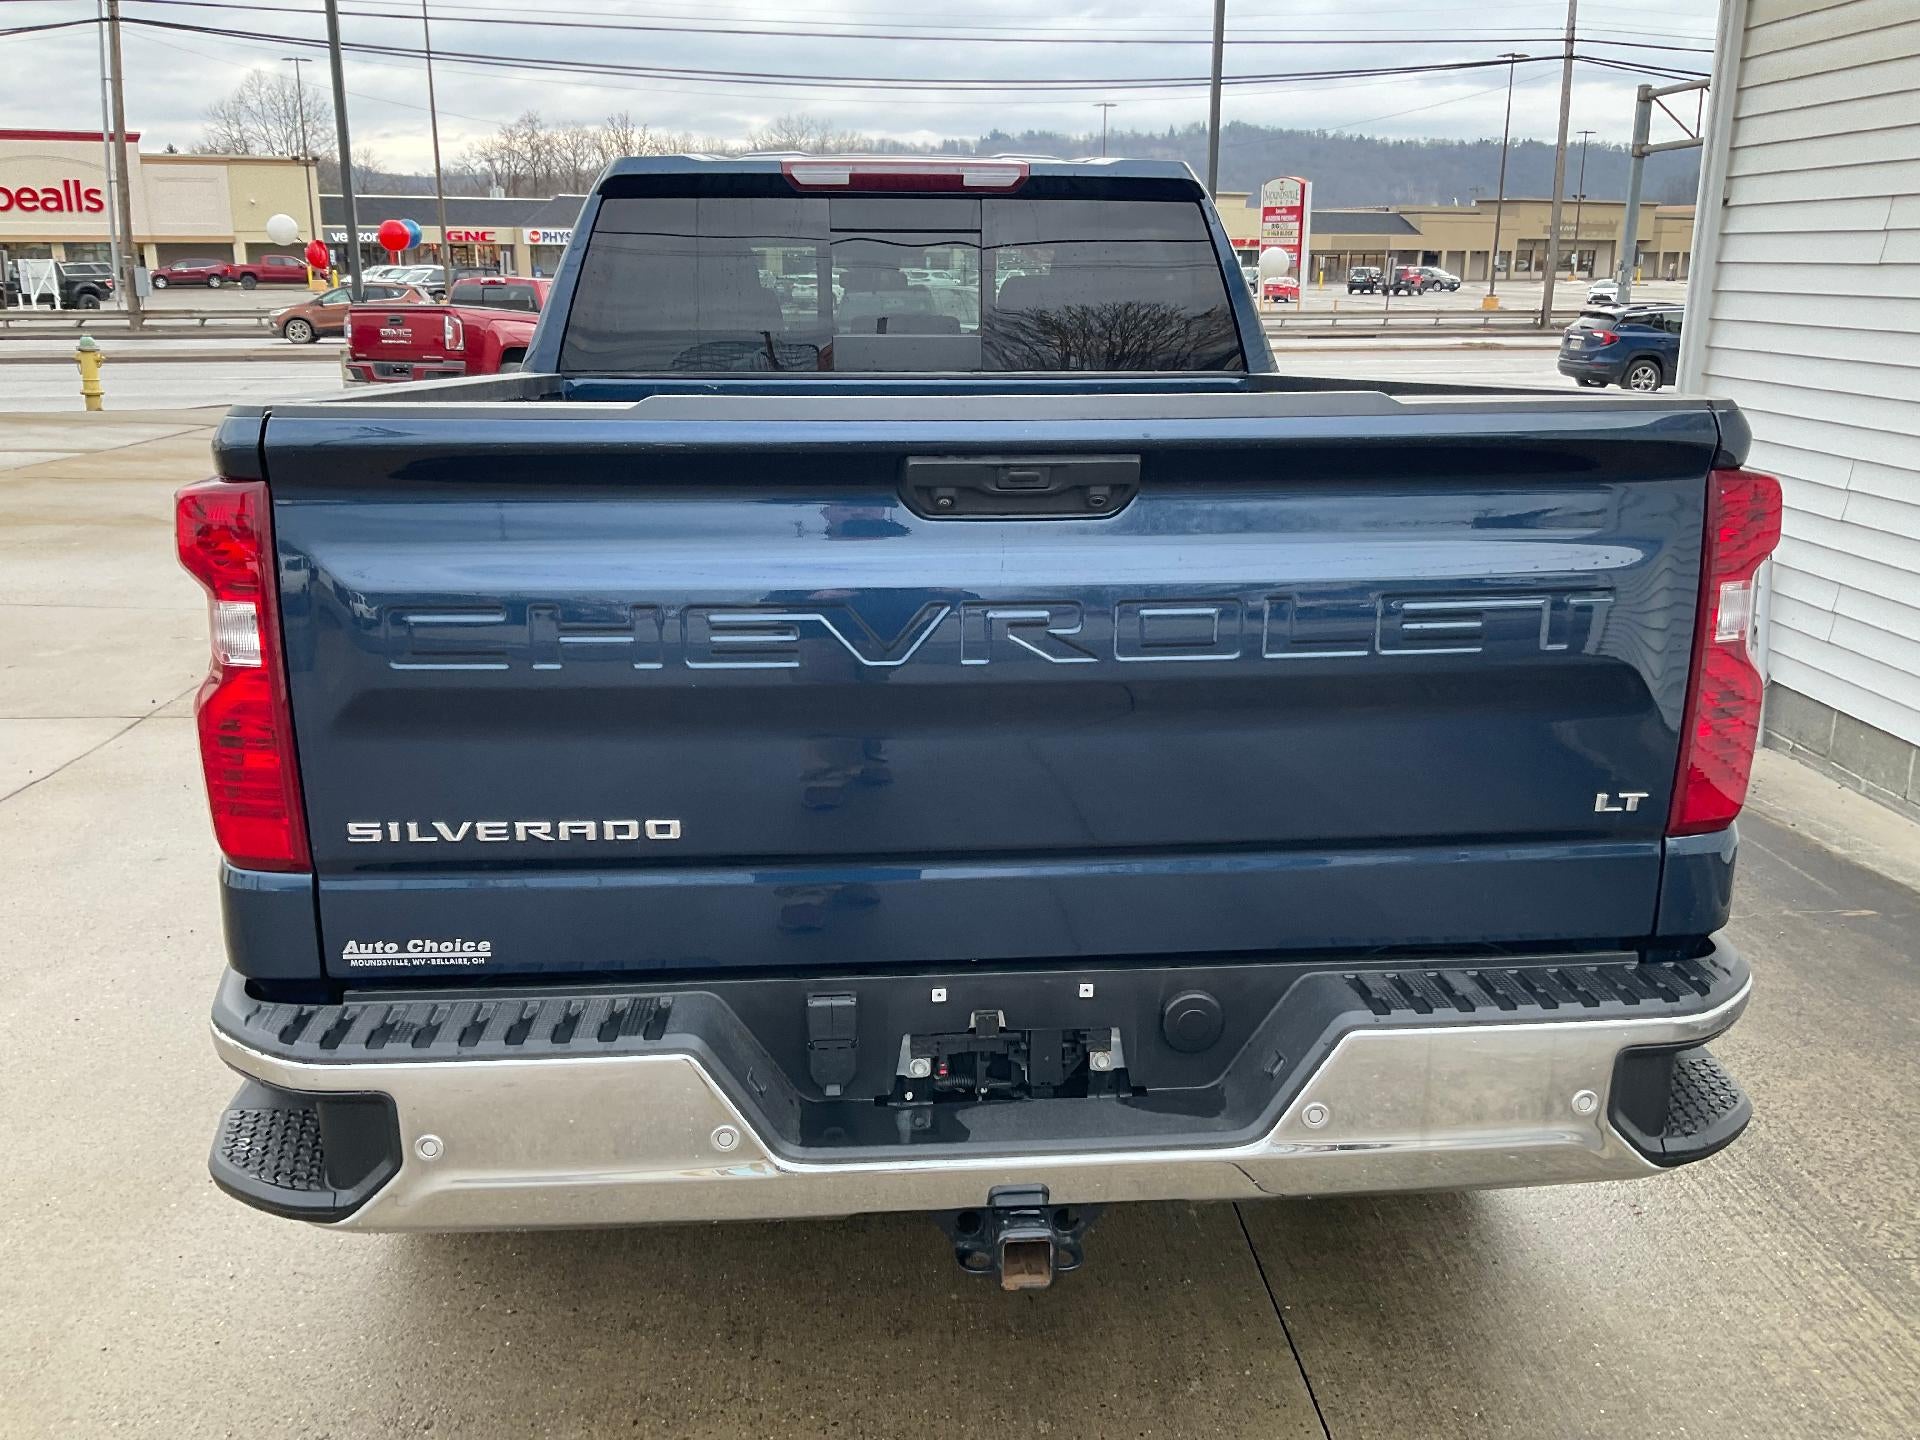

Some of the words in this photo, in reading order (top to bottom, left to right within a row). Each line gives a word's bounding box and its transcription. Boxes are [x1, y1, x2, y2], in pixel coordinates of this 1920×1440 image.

[446, 230, 496, 242] GNC
[384, 587, 1615, 668] CHEVROLET
[1594, 792, 1649, 812] LT
[347, 819, 682, 842] SILVERADO
[342, 940, 399, 954] Auto
[406, 938, 491, 953] Choice
